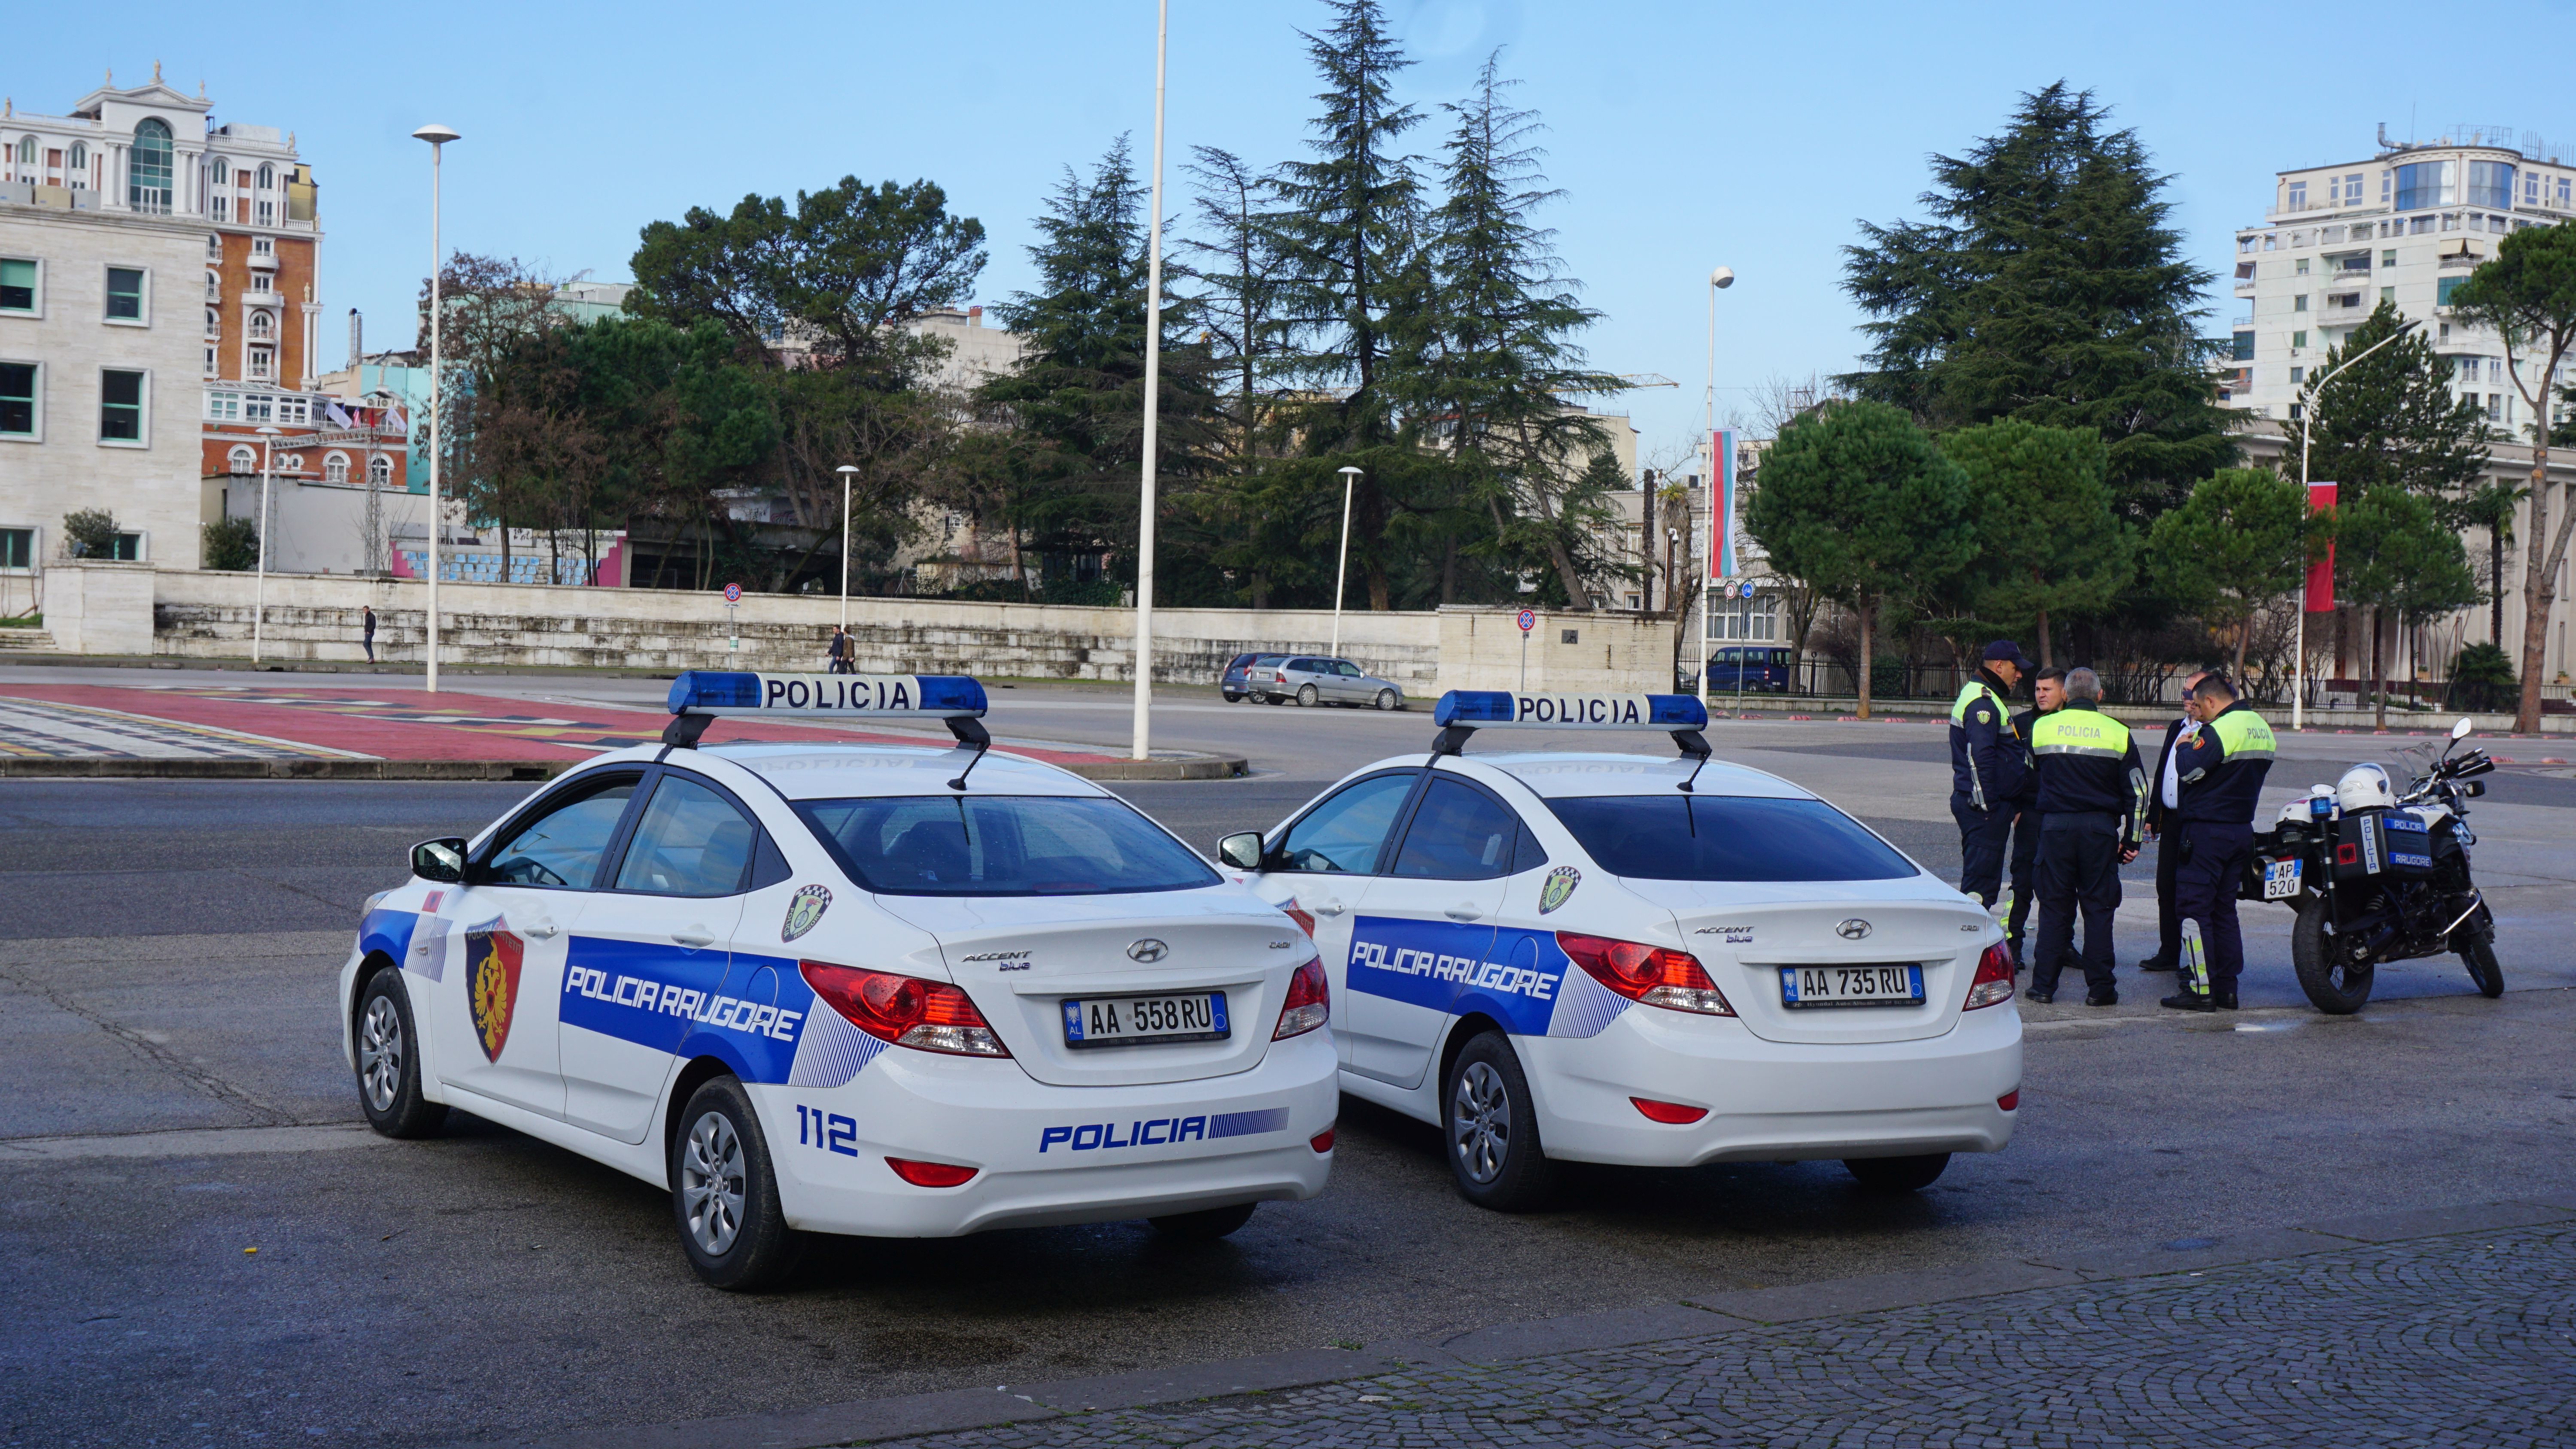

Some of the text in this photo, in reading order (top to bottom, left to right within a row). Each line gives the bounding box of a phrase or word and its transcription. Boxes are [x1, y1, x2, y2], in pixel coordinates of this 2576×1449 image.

[767, 679, 909, 709] POLICIA
[1519, 697, 1639, 724] POLICIA
[2058, 724, 2101, 739] POLICIA
[2246, 728, 2270, 740] POLICIA
[2394, 821, 2421, 831] POLICIA
[2363, 818, 2376, 870] POLICIA
[2395, 854, 2430, 866] RRUGORE
[2278, 864, 2293, 879] AP
[2269, 879, 2295, 896] 520
[1540, 885, 1573, 912] POLICIA RRUGORE
[784, 907, 822, 939] POLICIA RRUGORE
[1694, 926, 1755, 934] ACCENT
[468, 923, 493, 941] POLICIA
[496, 925, 522, 955] SHTETIT
[1726, 934, 1753, 943] blue
[961, 950, 1033, 962] ACCENT
[999, 961, 1031, 971] blue
[1351, 941, 1559, 1000] POLICIA RRUGORE
[1786, 989, 1797, 997] AL
[1804, 970, 1830, 996] AA
[565, 965, 802, 1042] POLICIA RRUGORE
[1091, 1003, 1121, 1035] AA
[1069, 1026, 1081, 1035] AL
[796, 1104, 858, 1158] 112
[1039, 1115, 1206, 1153] POLICIA
